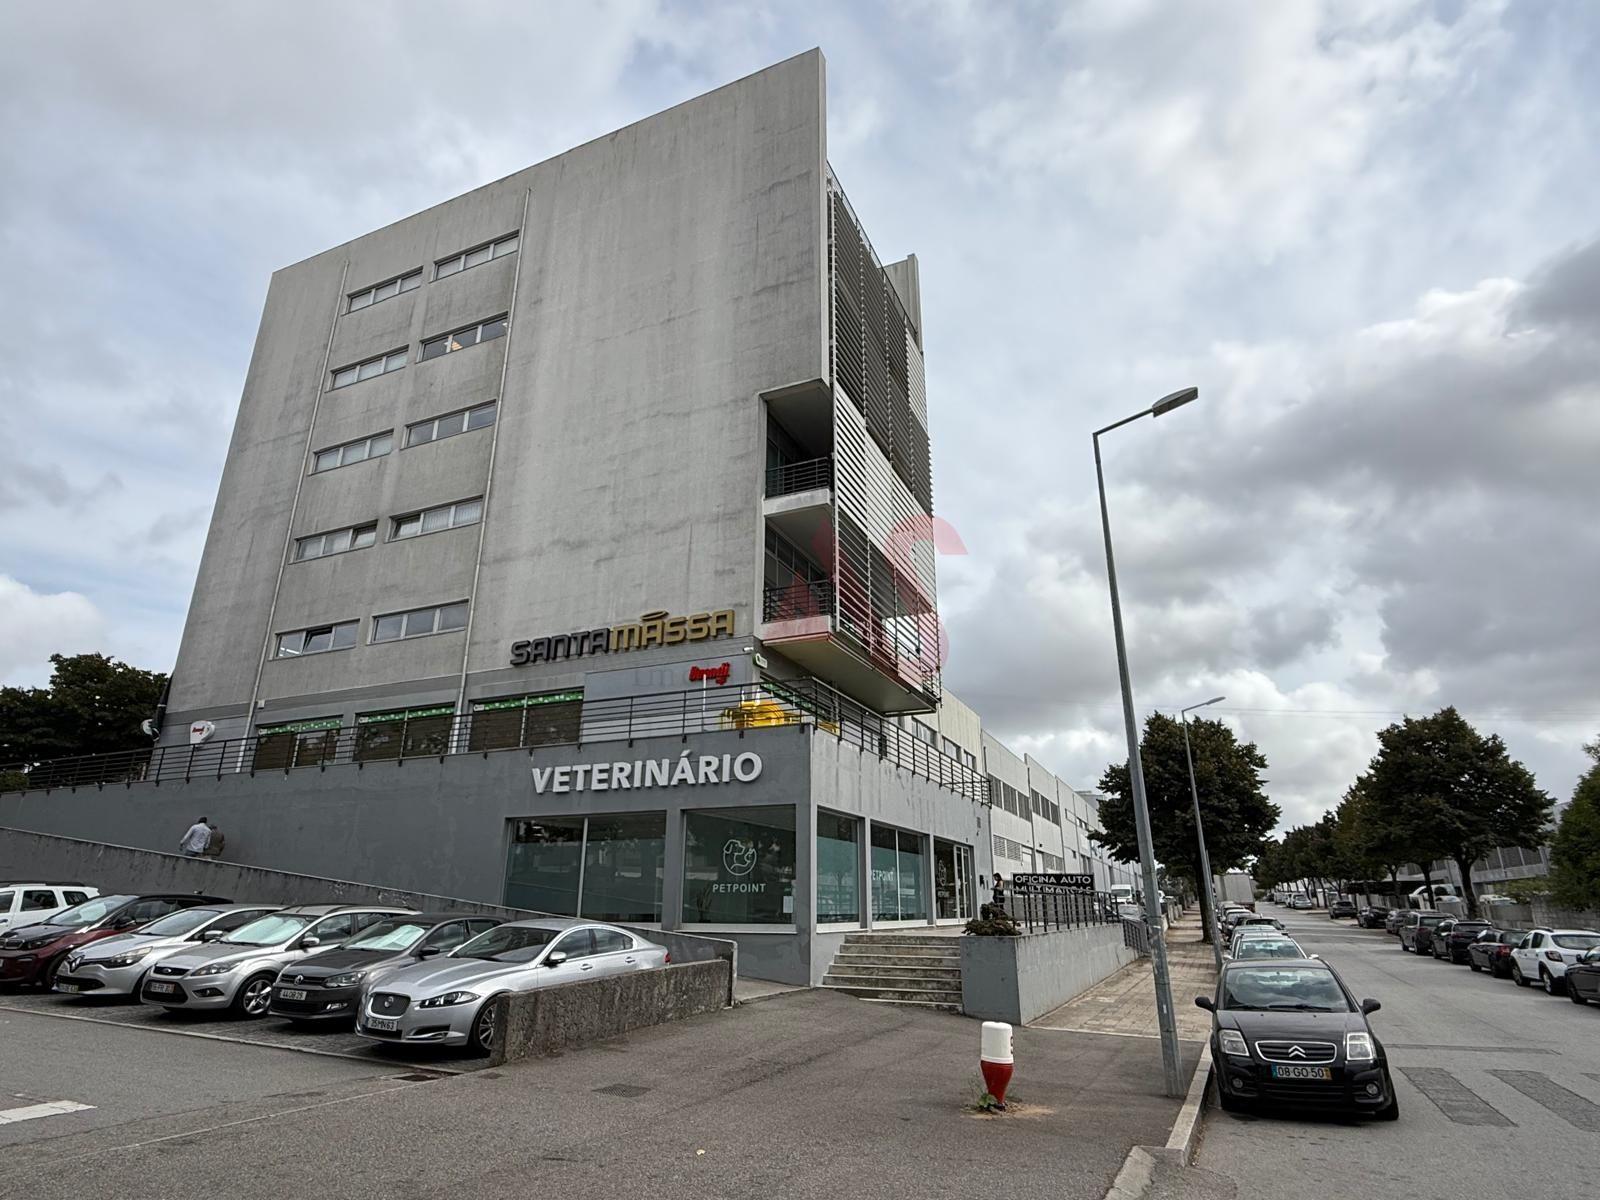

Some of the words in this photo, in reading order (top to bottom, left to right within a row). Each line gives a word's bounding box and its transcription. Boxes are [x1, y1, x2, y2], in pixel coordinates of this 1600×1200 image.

[532, 749, 762, 793] VETERINÁRIO
[1015, 875, 1057, 884] OFICINA
[1060, 876, 1091, 884] AUTO
[712, 883, 766, 893] PETPOINT
